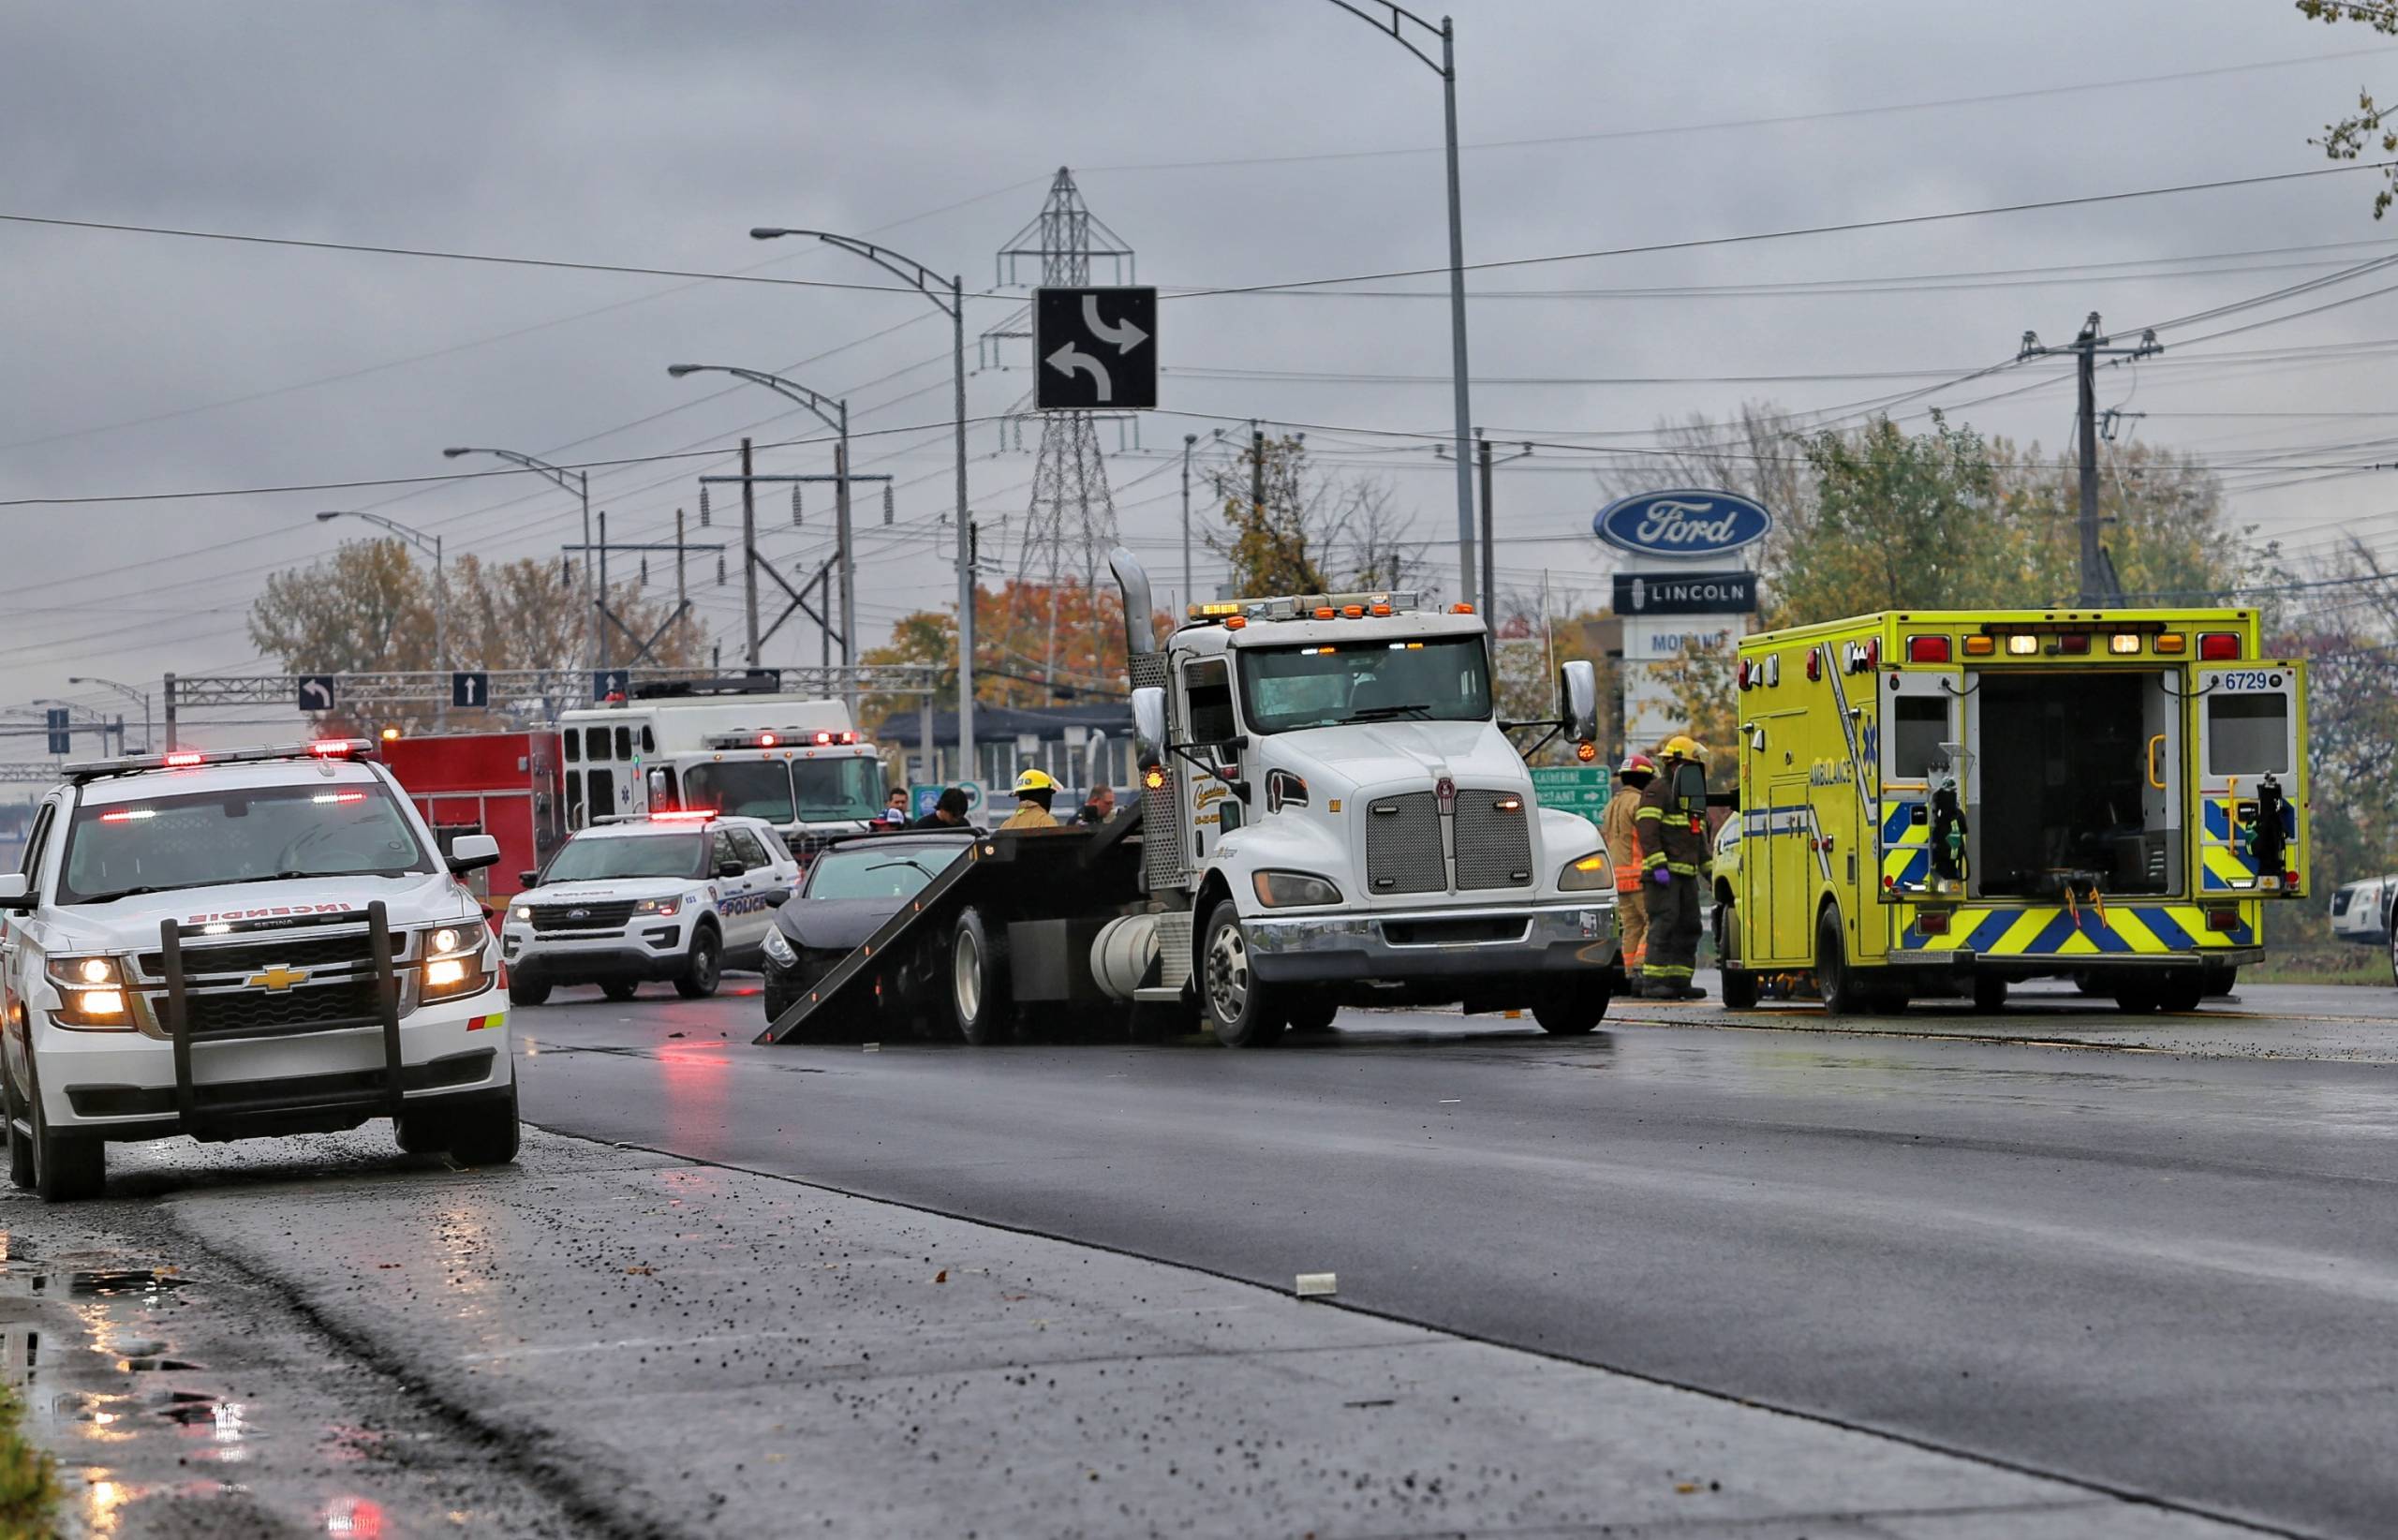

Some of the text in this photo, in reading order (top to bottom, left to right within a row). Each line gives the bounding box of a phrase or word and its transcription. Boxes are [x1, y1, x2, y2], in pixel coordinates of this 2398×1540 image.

[1636, 500, 1739, 543] Ford
[1652, 585, 1744, 601] LINCOLN
[2225, 672, 2267, 690] 6729
[1596, 771, 1606, 782] 2
[1810, 760, 1852, 787] AMBULANCE
[725, 894, 766, 917] POLICE
[254, 918, 293, 929] SETINA
